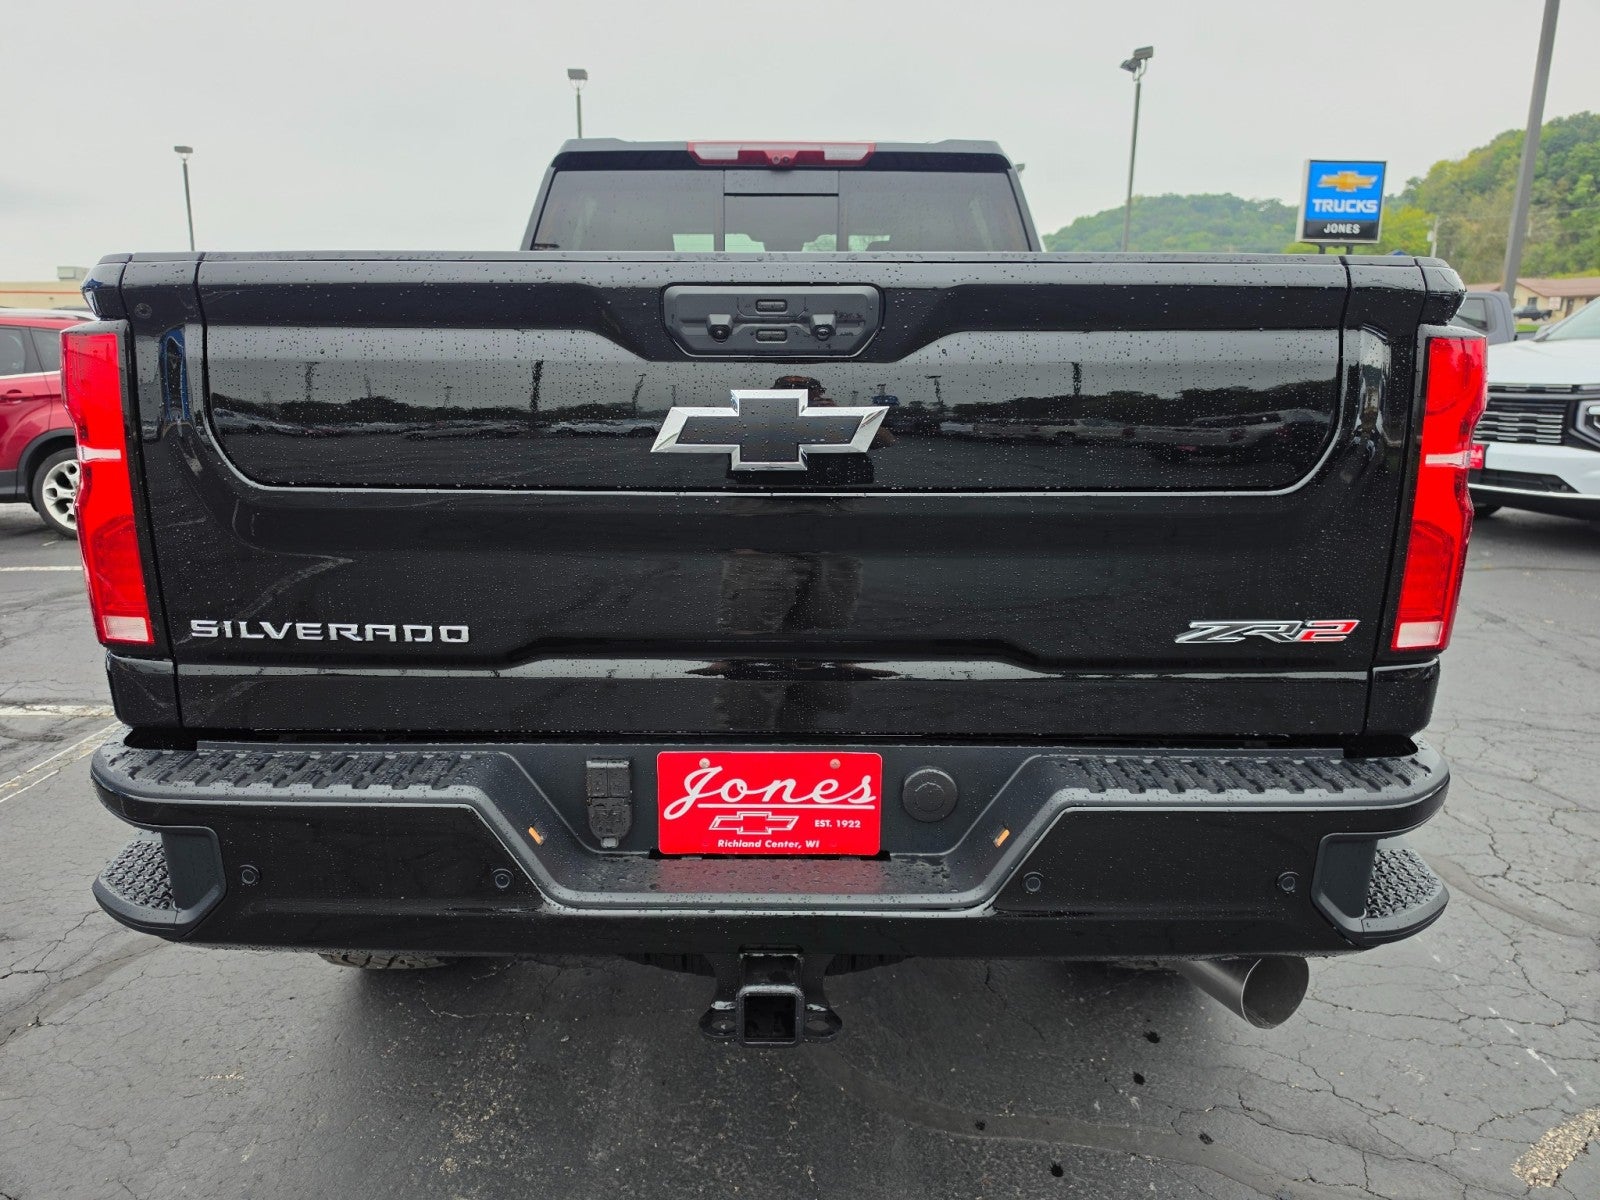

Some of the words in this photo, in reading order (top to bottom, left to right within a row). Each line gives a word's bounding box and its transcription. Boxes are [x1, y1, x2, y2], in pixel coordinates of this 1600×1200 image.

[1312, 199, 1378, 213] TRUCKS
[1323, 223, 1360, 234] JONES
[190, 619, 469, 643] SILVERADO
[1174, 619, 1360, 643] ZR2
[663, 765, 876, 820] Jones
[814, 819, 832, 828] EST.
[836, 819, 861, 828] 1922
[717, 839, 761, 848] Richland
[764, 839, 802, 849] Center,
[805, 840, 820, 848] WI
